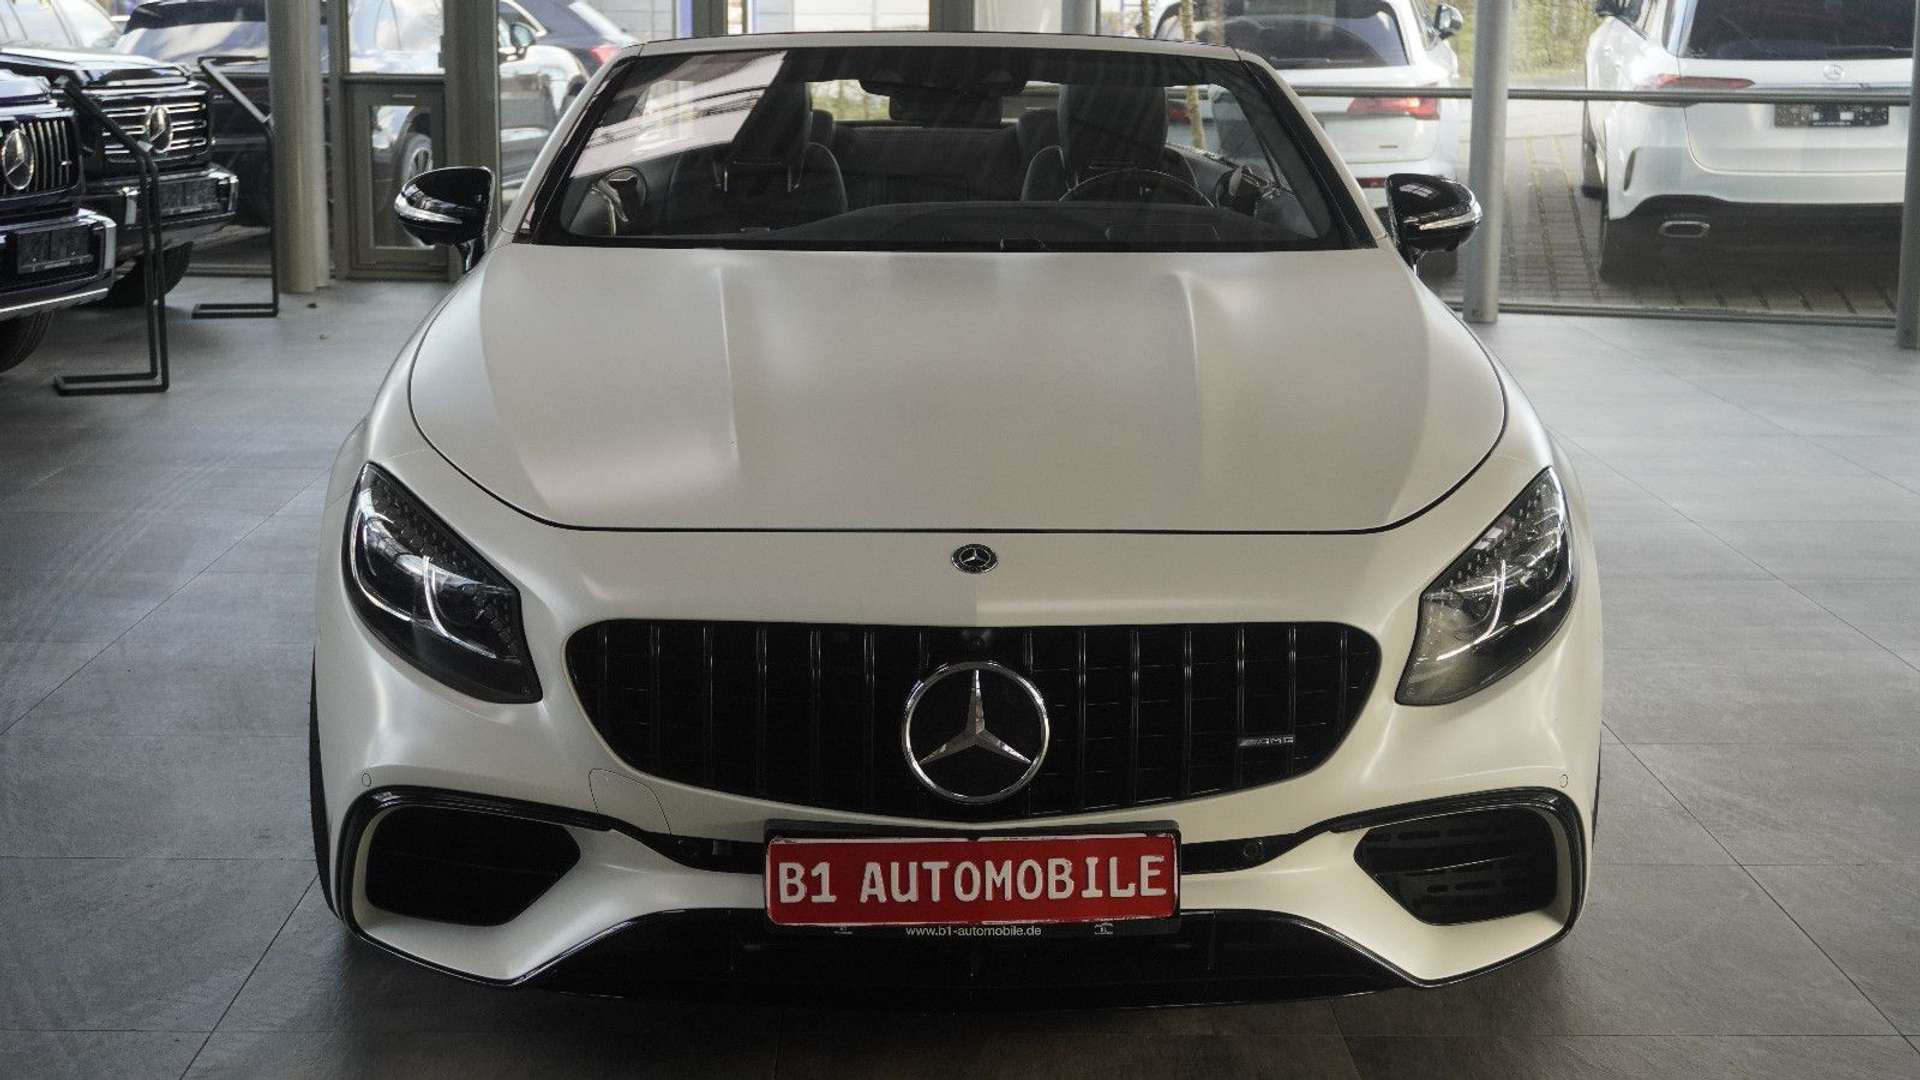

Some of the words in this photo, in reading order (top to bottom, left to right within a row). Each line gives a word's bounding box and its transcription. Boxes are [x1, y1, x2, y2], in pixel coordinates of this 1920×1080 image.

[778, 861, 837, 904] B1
[859, 854, 1168, 904] AUTOMOBILE
[905, 925, 1042, 937] www.b1-automobile.de
